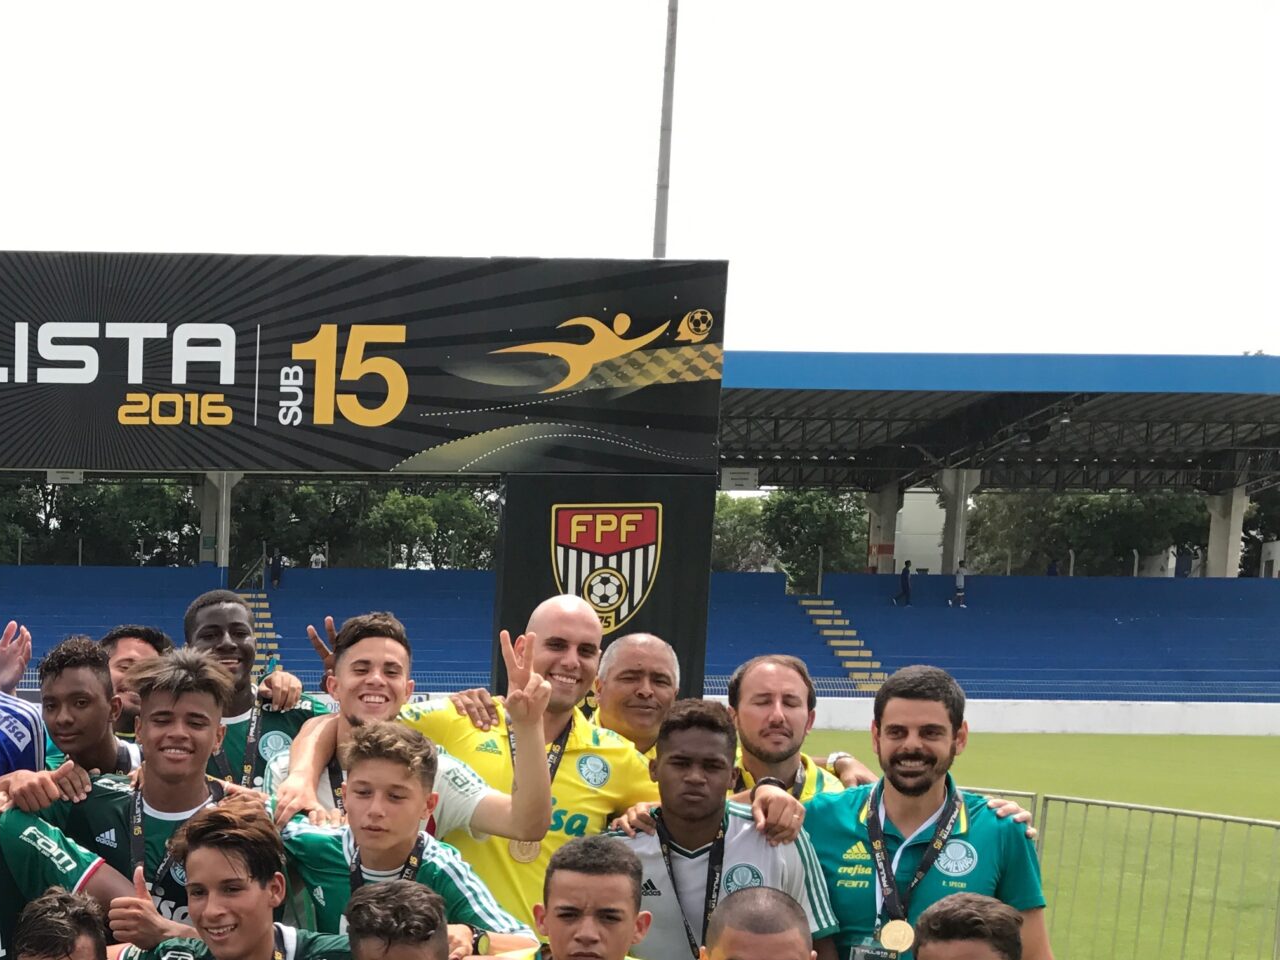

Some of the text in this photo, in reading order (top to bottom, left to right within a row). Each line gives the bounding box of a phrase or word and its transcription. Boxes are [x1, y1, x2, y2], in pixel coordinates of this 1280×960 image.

[278, 324, 408, 427] SUB 15
[117, 394, 233, 425] 2016
[570, 513, 643, 543] FPF
[940, 806, 961, 840] PAULISTA
[95, 836, 118, 848] adidas
[842, 852, 871, 860] adidas
[838, 865, 872, 876] crefisa
[875, 851, 889, 890] PAULISTA
